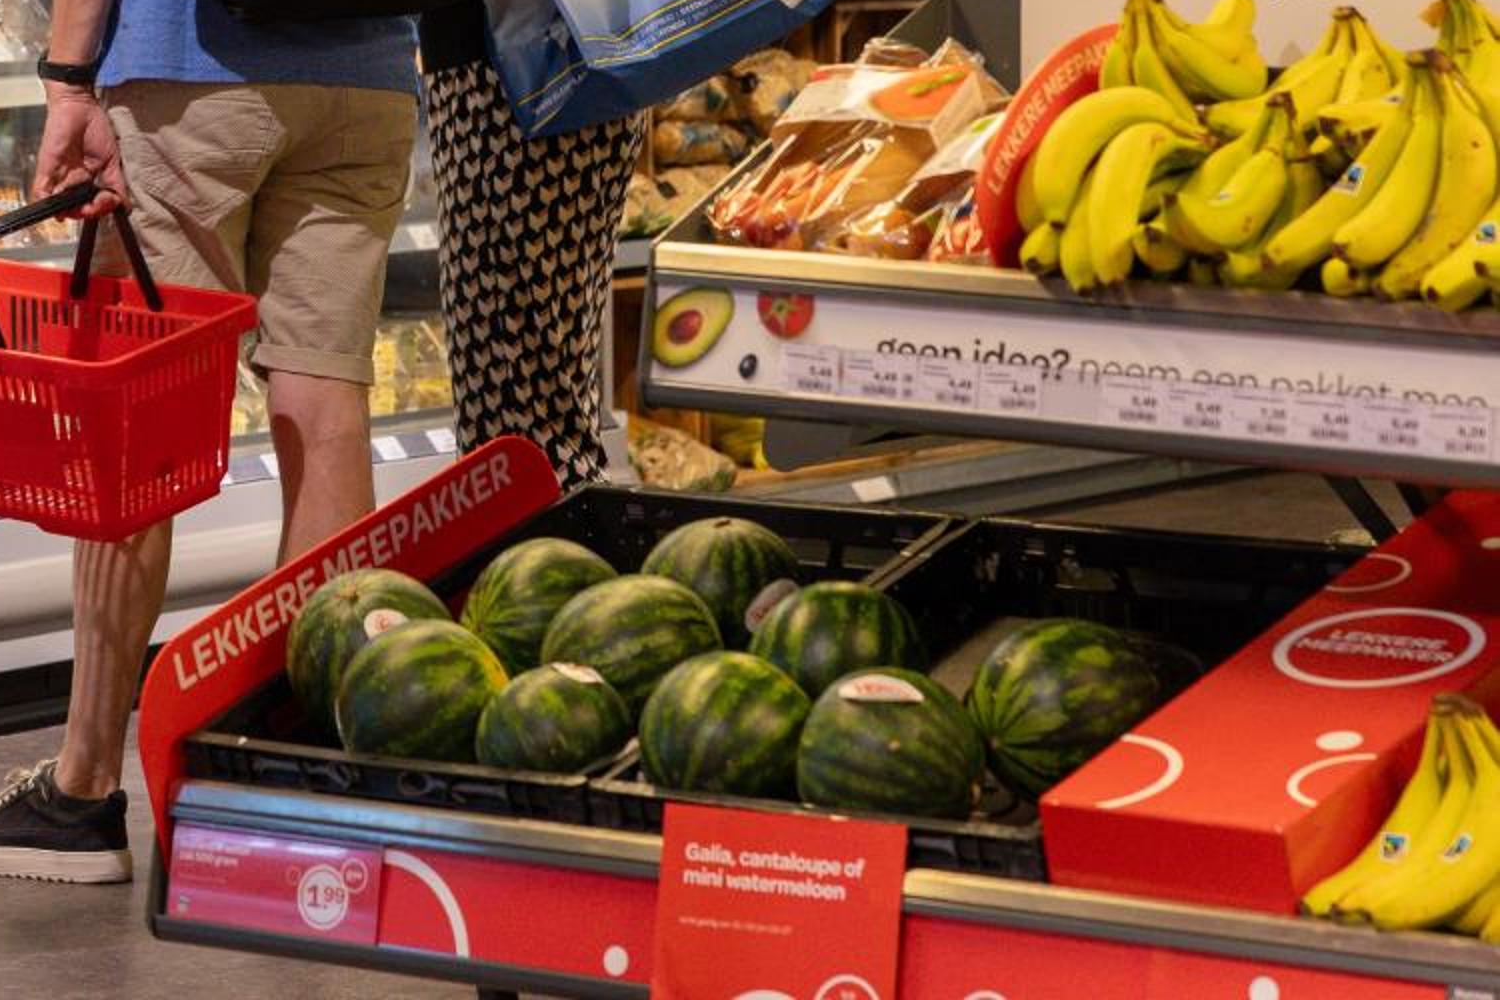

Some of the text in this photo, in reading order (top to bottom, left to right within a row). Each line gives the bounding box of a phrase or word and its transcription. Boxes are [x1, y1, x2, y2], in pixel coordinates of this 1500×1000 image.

[172, 452, 512, 692] LEKKERE MEEPAKKER
[1329, 629, 1449, 650] LEKKERE
[684, 841, 866, 879] Galia, cantaloupe of
[307, 884, 346, 910] 1.99
[682, 866, 847, 901] mini watermeloen
